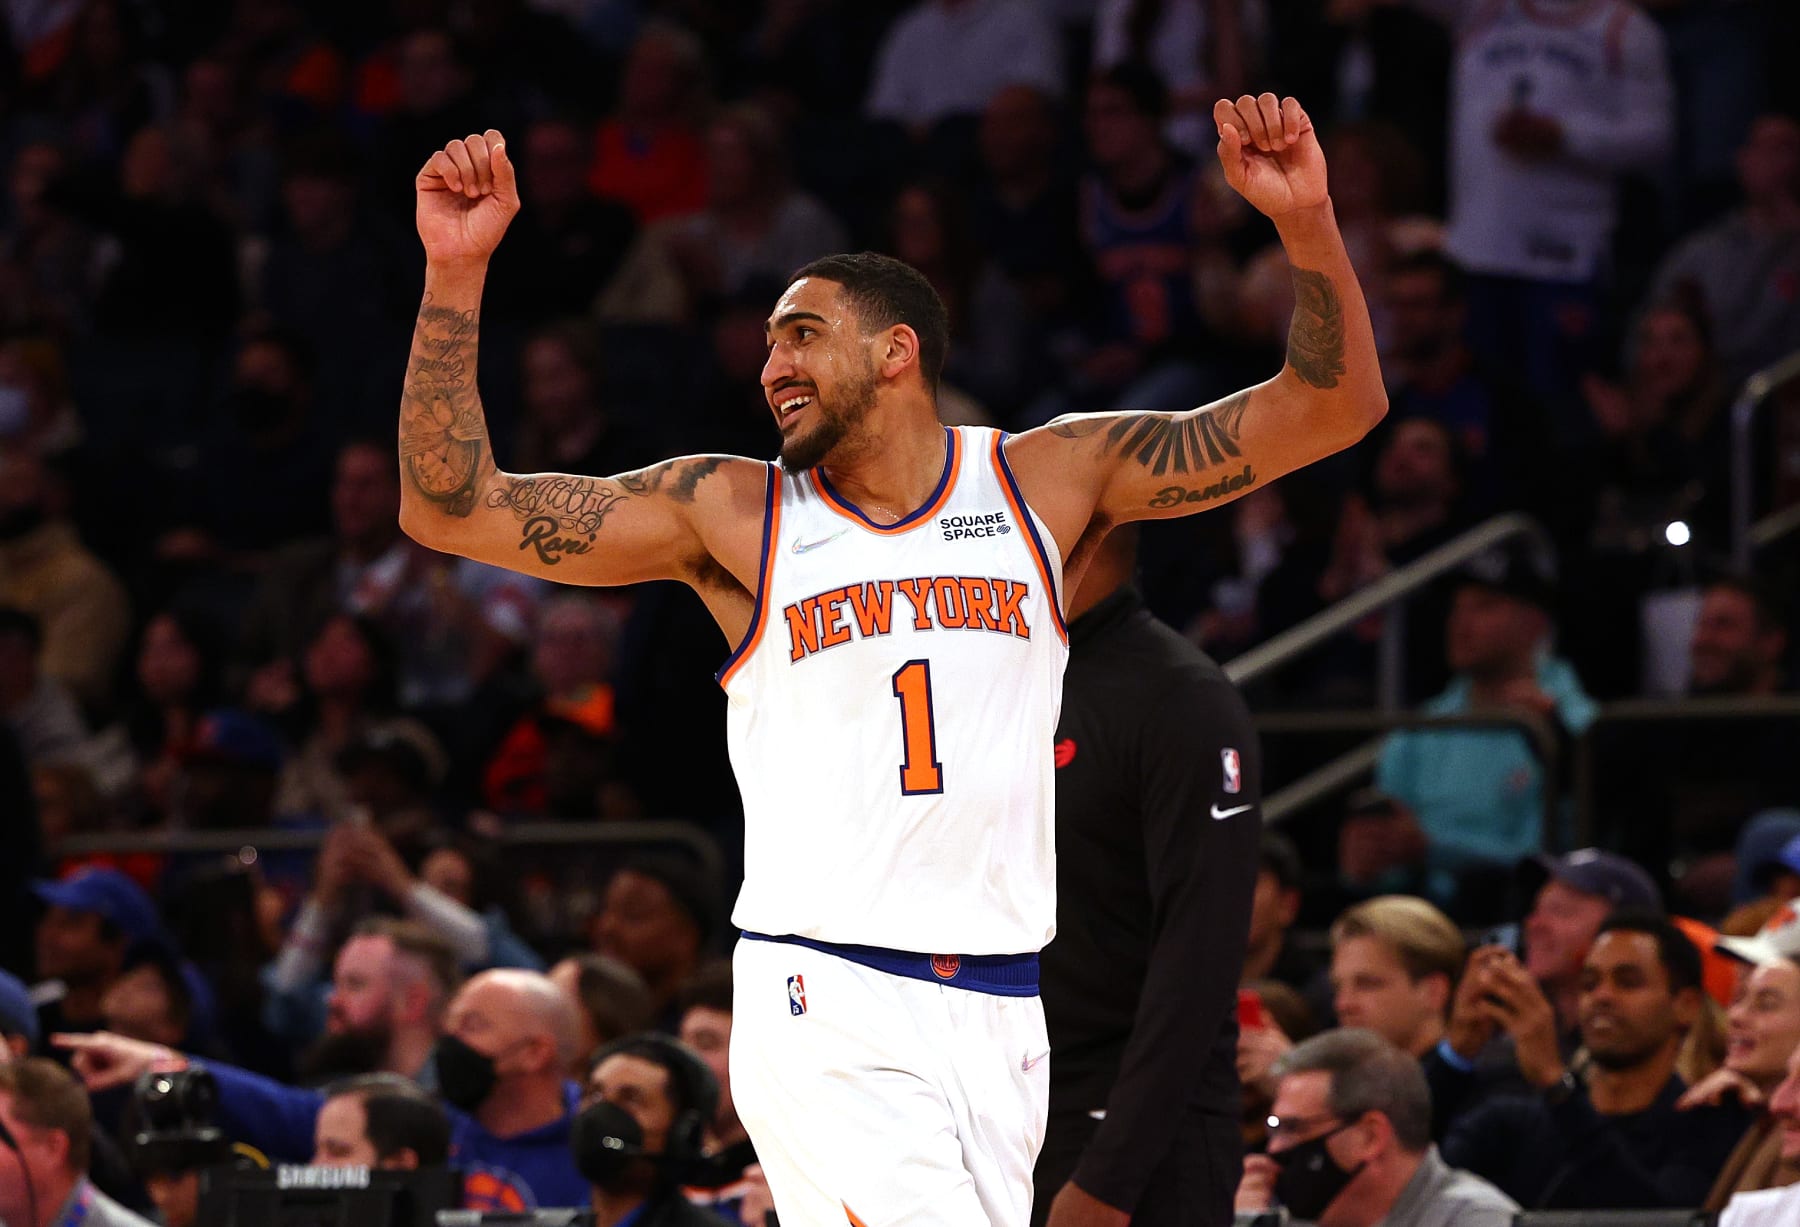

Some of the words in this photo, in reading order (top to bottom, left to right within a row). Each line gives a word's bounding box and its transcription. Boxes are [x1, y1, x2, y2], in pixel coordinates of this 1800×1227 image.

[1148, 465, 1256, 509] Daniel
[519, 516, 597, 565] Rani
[940, 511, 1006, 530] SQUARE
[943, 526, 996, 541] SPACE
[783, 579, 895, 666] NEW
[897, 575, 1032, 642] YORK
[892, 659, 944, 796] 1
[277, 1163, 371, 1189] SAMSUNG
